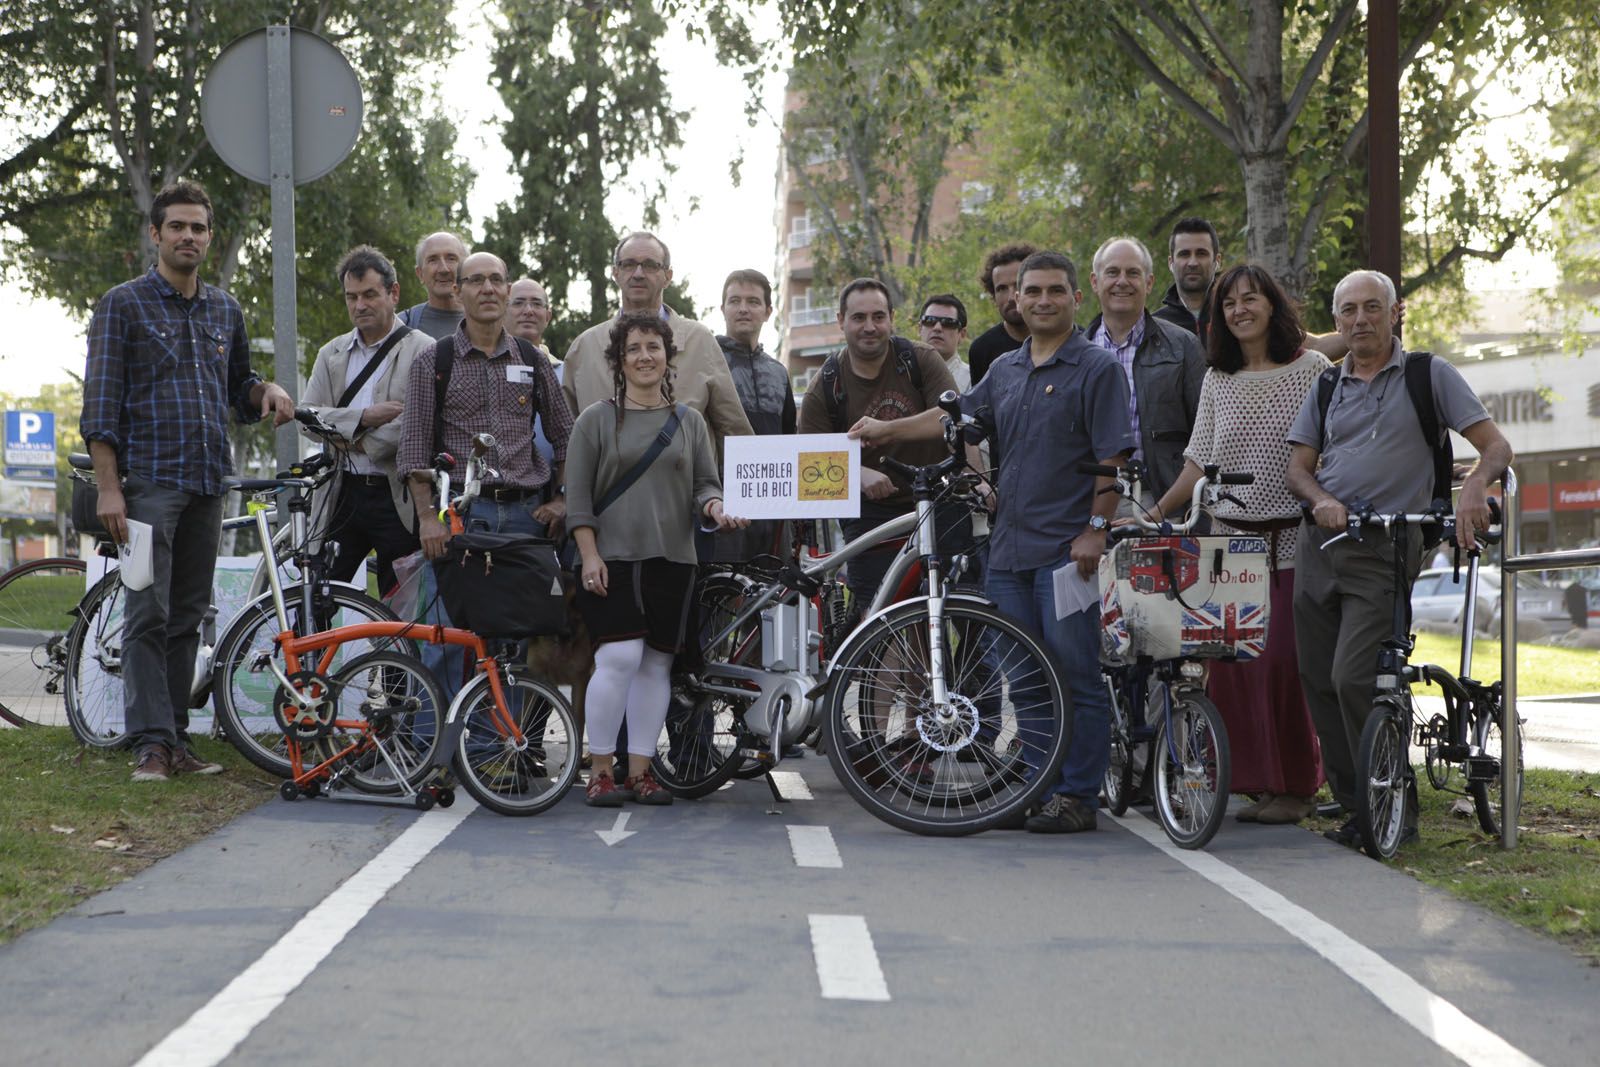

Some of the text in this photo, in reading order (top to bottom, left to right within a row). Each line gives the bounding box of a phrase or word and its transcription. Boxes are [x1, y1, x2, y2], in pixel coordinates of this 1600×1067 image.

[19, 412, 42, 443] P
[736, 462, 793, 480] ASSEMBLEA
[741, 481, 792, 498] DE LA BICI
[804, 488, 821, 497] Sant
